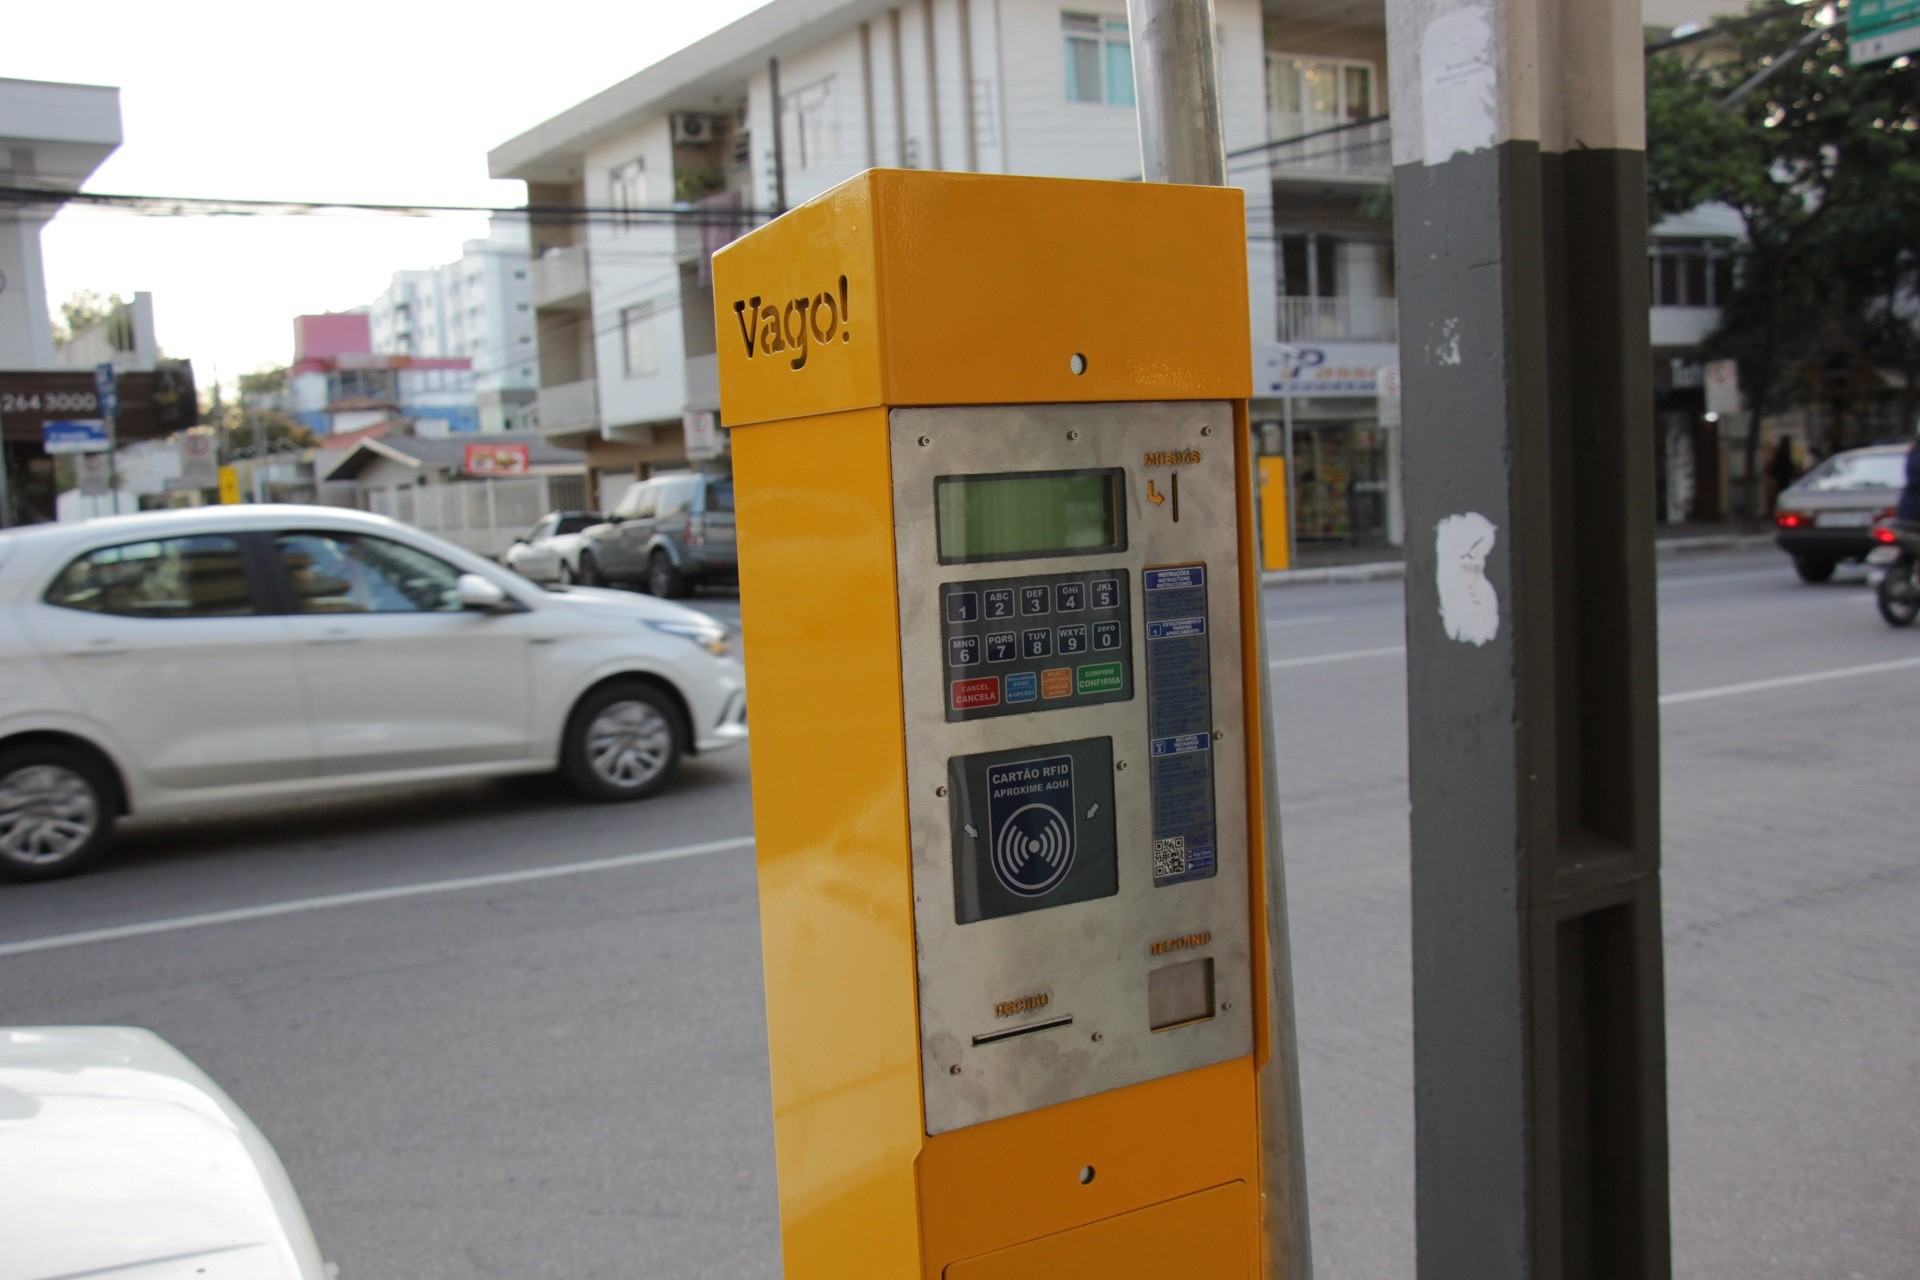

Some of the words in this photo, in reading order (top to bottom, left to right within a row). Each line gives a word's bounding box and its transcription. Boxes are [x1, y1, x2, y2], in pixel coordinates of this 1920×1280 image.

[733, 274, 850, 371] Vago!
[44, 392, 97, 412] 3000
[1144, 450, 1201, 466] MOEDAS
[1157, 570, 1190, 578] INSTRUÇÕES
[1026, 589, 1043, 598] DEF
[1062, 586, 1079, 595] GHI
[1097, 583, 1113, 592] JKL
[990, 592, 1009, 602] ABC
[1066, 596, 1076, 609] 4
[1101, 593, 1110, 606] 5
[995, 603, 1005, 616] 2
[1031, 599, 1040, 612] 3
[959, 606, 967, 619] 1
[1097, 625, 1116, 633] zero
[1163, 619, 1202, 628] ESTACIONAMENTO
[1028, 632, 1047, 641] TUV
[1060, 628, 1085, 638] WXYZ
[953, 639, 976, 649] MNO
[989, 635, 1014, 645] PQRS
[1067, 637, 1077, 651] 9
[1102, 633, 1111, 647] 0
[997, 645, 1007, 659] 7
[1033, 641, 1043, 655] 8
[960, 649, 970, 663] 6
[1085, 668, 1115, 677] CONFIRM
[961, 684, 989, 693] CANCEL
[1079, 677, 1121, 688] CONFIRMA
[956, 692, 996, 704] CANCELA
[1013, 690, 1035, 698] OPÇÕES
[1174, 740, 1199, 748] RECHARGE
[992, 767, 1040, 785] CARTÃO
[1043, 764, 1069, 778] RFID
[993, 783, 1044, 799] APROXIME
[1046, 779, 1069, 791] AQUI
[1149, 932, 1211, 956] RETORNO
[995, 994, 1048, 1017] RECIBO
